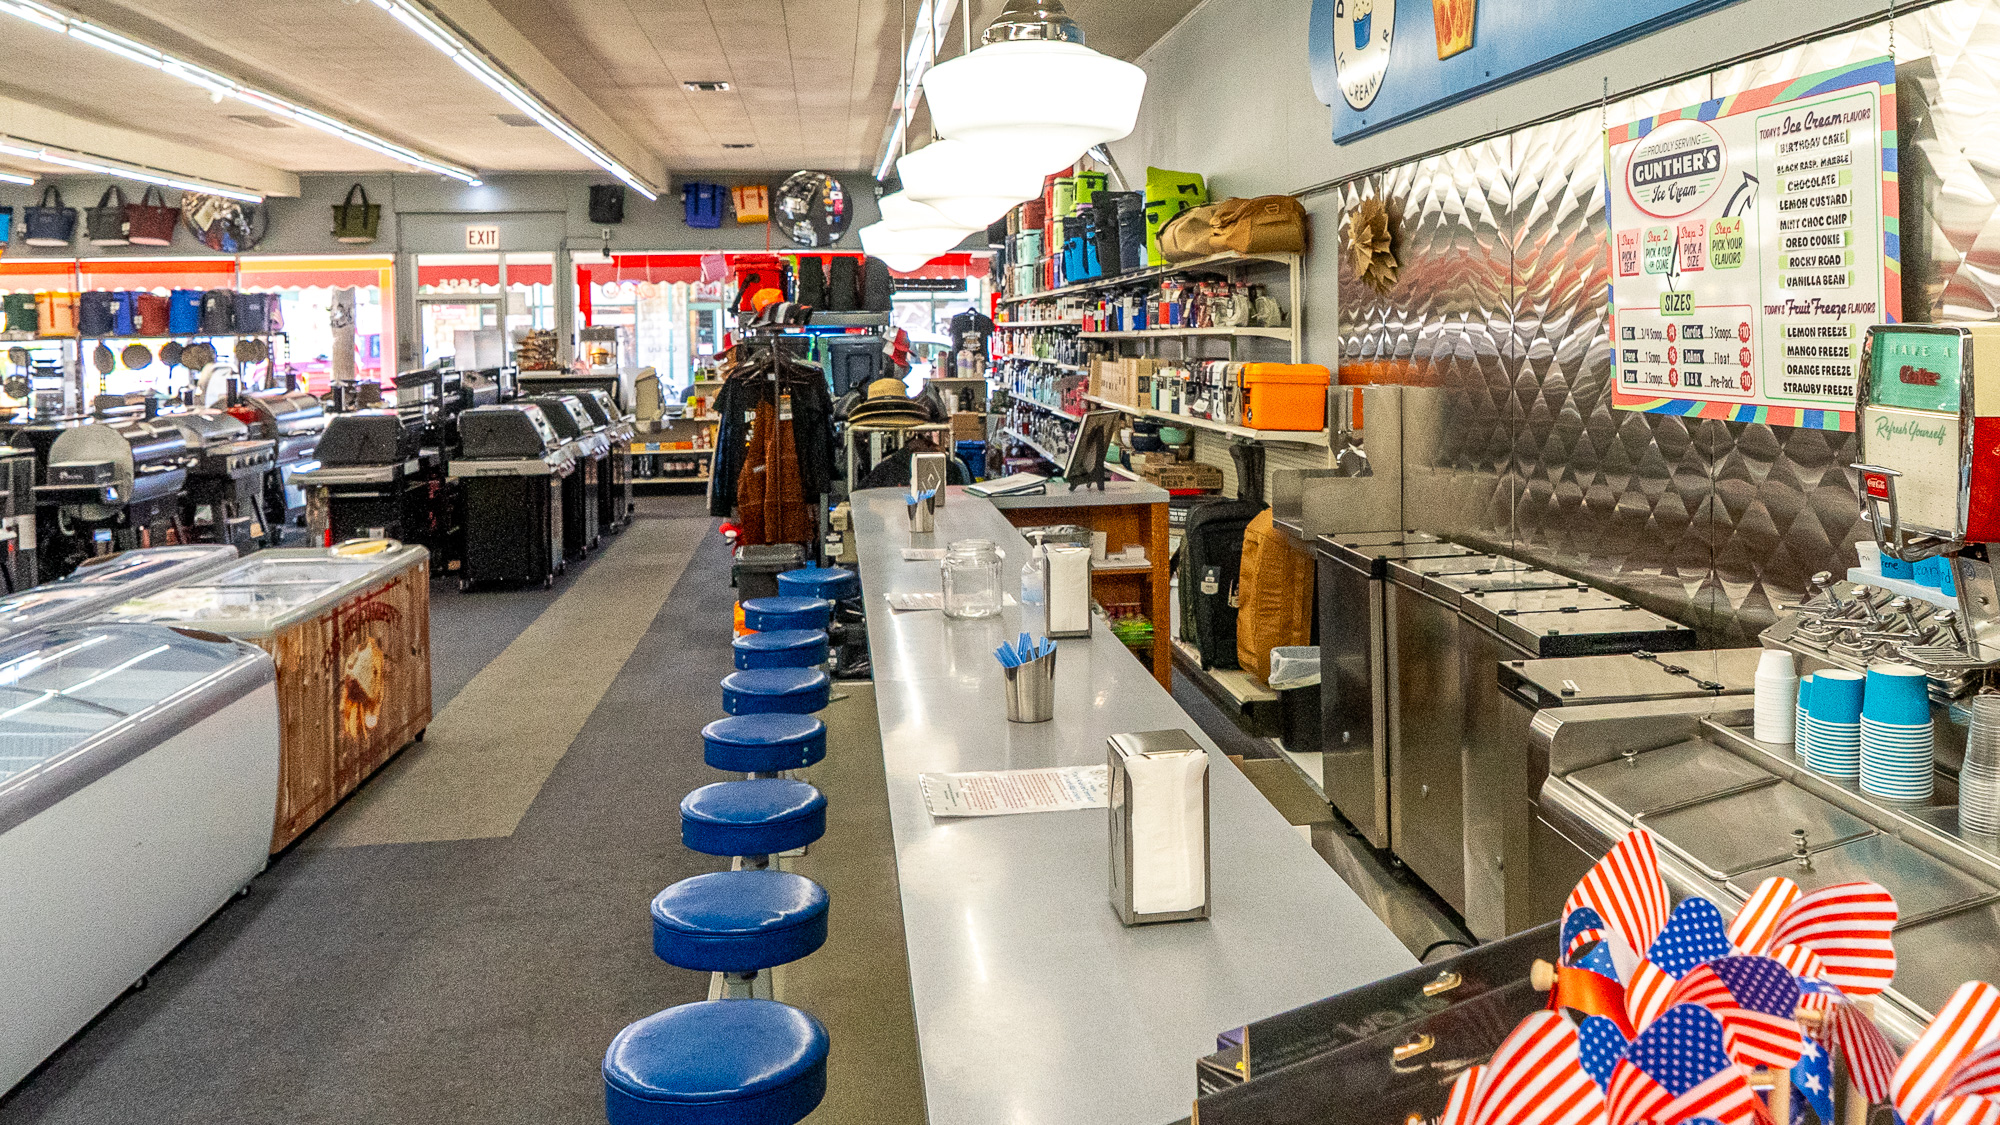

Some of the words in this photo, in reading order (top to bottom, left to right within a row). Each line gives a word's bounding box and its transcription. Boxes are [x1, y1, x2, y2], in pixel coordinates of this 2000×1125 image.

[1349, 74, 1377, 101] CREAM
[1760, 126, 1781, 140] TODAY'S
[1781, 115, 1802, 136] Ice
[1804, 110, 1842, 130] Cream
[1843, 108, 1871, 124] FLAVORS
[1647, 142, 1675, 156] PROUDLY
[1674, 134, 1701, 150] SERVING
[1780, 137, 1820, 154] BIRTHDAY
[1822, 132, 1846, 147] CAKE
[1635, 149, 1718, 183] GUNTHER'S
[1777, 162, 1799, 174] BLACK
[1800, 159, 1819, 171] RASP.
[1820, 154, 1849, 168] MARBLE
[1787, 174, 1836, 191] CHOCOLATE
[1651, 184, 1666, 204] Ice
[1667, 181, 1697, 204] Cream
[1780, 197, 1809, 211] LEMON
[1809, 193, 1848, 207] CUSTARD
[1780, 219, 1801, 231] MINT
[1801, 216, 1825, 228] CHOC
[1826, 213, 1848, 226] CHIP
[469, 230, 496, 245] EXIT
[1647, 230, 1662, 246] Step
[1663, 229, 1669, 241] 2
[1680, 226, 1697, 243] Step
[1698, 224, 1704, 238] 3
[1714, 221, 1732, 240] Step
[1734, 220, 1741, 233] 4
[1621, 233, 1635, 250] Step
[1635, 232, 1640, 245] 1
[1711, 239, 1726, 252] PICK
[1726, 236, 1743, 250] YOUR
[1786, 236, 1809, 248] OREO
[1810, 233, 1841, 247] COOKIE
[1621, 251, 1632, 261] PICK
[1632, 250, 1637, 259] A
[1645, 247, 1656, 259] PICK
[1656, 247, 1661, 257] A
[1661, 245, 1672, 257] CUP
[1683, 243, 1698, 255] PICK
[1697, 242, 1703, 254] A
[1655, 259, 1669, 271] CONE
[1686, 255, 1700, 268] SIZE
[1714, 251, 1741, 265] FLAVORS
[1789, 255, 1817, 268] ROCKY
[1819, 254, 1841, 266] ROAD
[1623, 261, 1636, 273] SEAT
[1786, 275, 1822, 287] VANILLA
[1822, 273, 1846, 286] BEAN
[1664, 293, 1692, 312] SIZES
[1764, 305, 1785, 316] TODAY'S
[1785, 298, 1811, 318] Fruit
[1811, 297, 1848, 321] Freeze
[1847, 302, 1877, 315] FLAVORS
[1640, 327, 1650, 341] 3/4
[1649, 328, 1663, 341] Scoop
[1683, 325, 1702, 339] Gordie
[1709, 325, 1714, 339] 3
[1714, 326, 1732, 341] Scoops
[1739, 326, 1750, 339] $10
[1787, 326, 1816, 338] LEMON
[1817, 326, 1848, 338] FREEZE
[1648, 351, 1661, 365] Scoop
[1714, 351, 1730, 365] Float
[1740, 351, 1750, 364] $10
[1787, 345, 1817, 357] MANGO
[1818, 346, 1849, 358] FREEZE
[1889, 344, 1931, 358] HAVE
[1943, 346, 1952, 359] A
[1787, 364, 1821, 376] ORANGE
[1821, 365, 1852, 377] FREEZE
[1648, 372, 1663, 386] Scoops
[1710, 375, 1734, 389] Pre-Pack
[1741, 374, 1751, 387] $10
[1783, 382, 1821, 393] STRAWBY
[1822, 384, 1854, 397] FREEZE
[1875, 415, 1908, 441] Refresh
[1908, 420, 1947, 446] Yourself
[1881, 559, 1899, 571] rene
